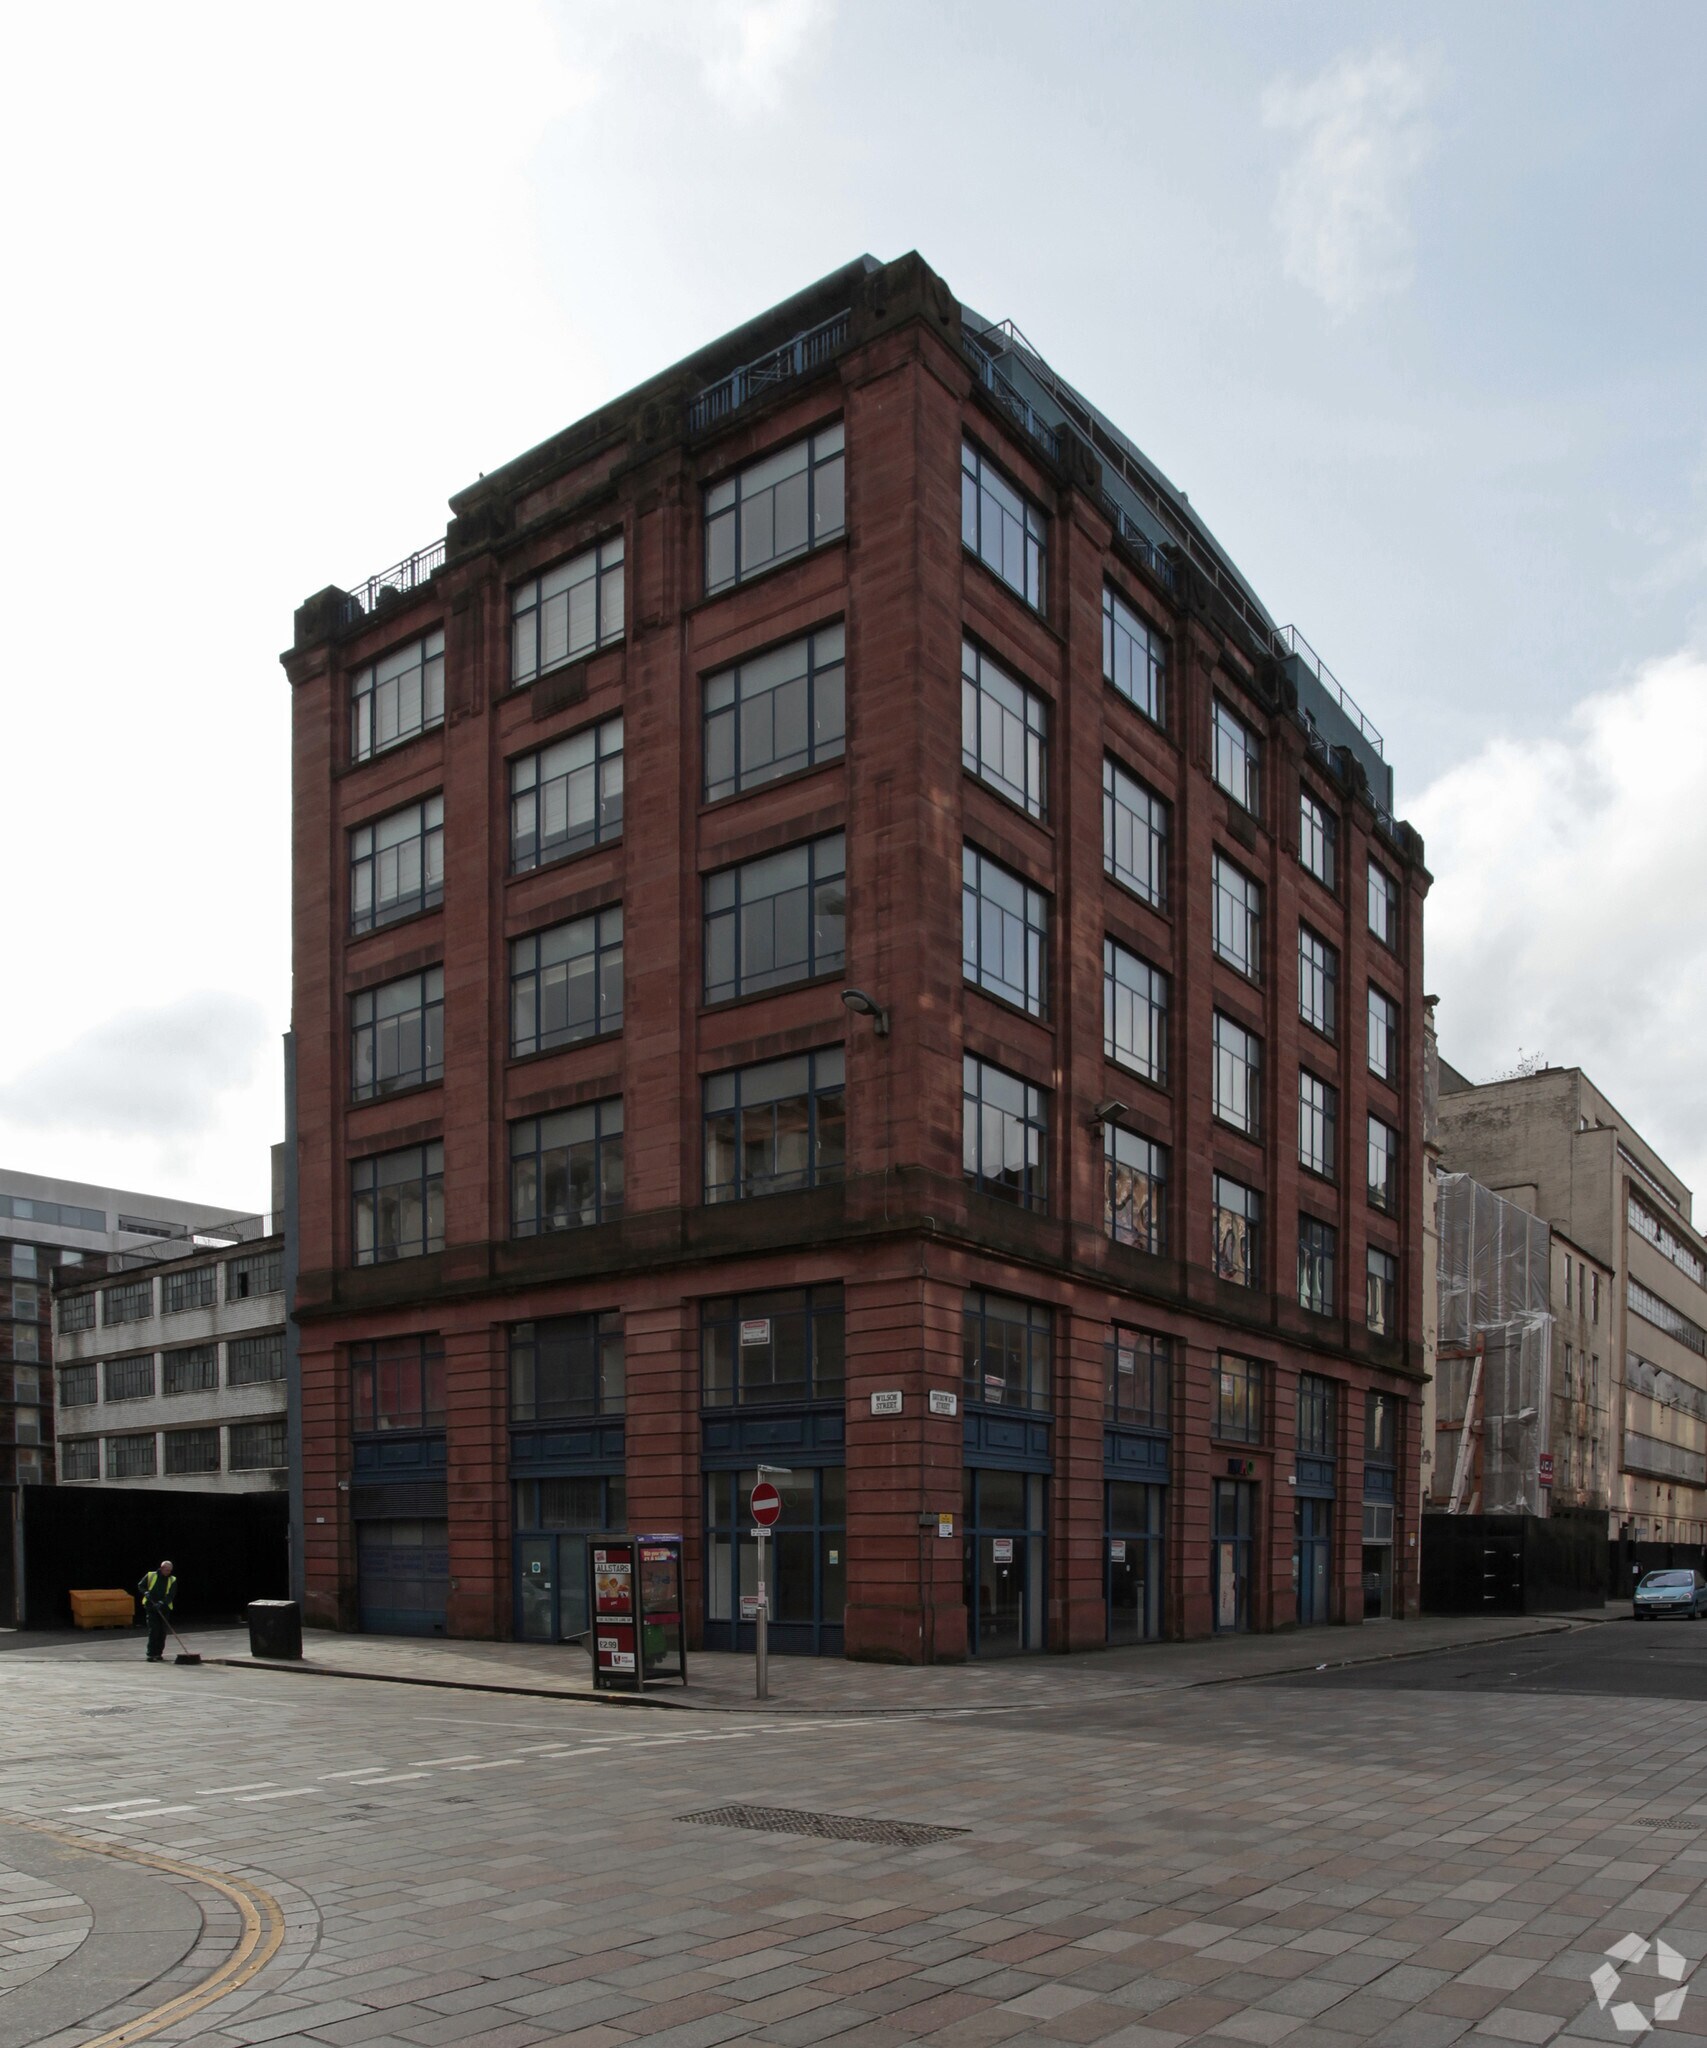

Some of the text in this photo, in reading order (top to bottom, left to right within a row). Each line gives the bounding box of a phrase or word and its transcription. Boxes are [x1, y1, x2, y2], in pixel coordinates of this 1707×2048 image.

[876, 1401, 897, 1409] STREET
[936, 1402, 950, 1410] STREET
[596, 1564, 630, 1573] ALLSTARS
[599, 1640, 617, 1649] £2.99
